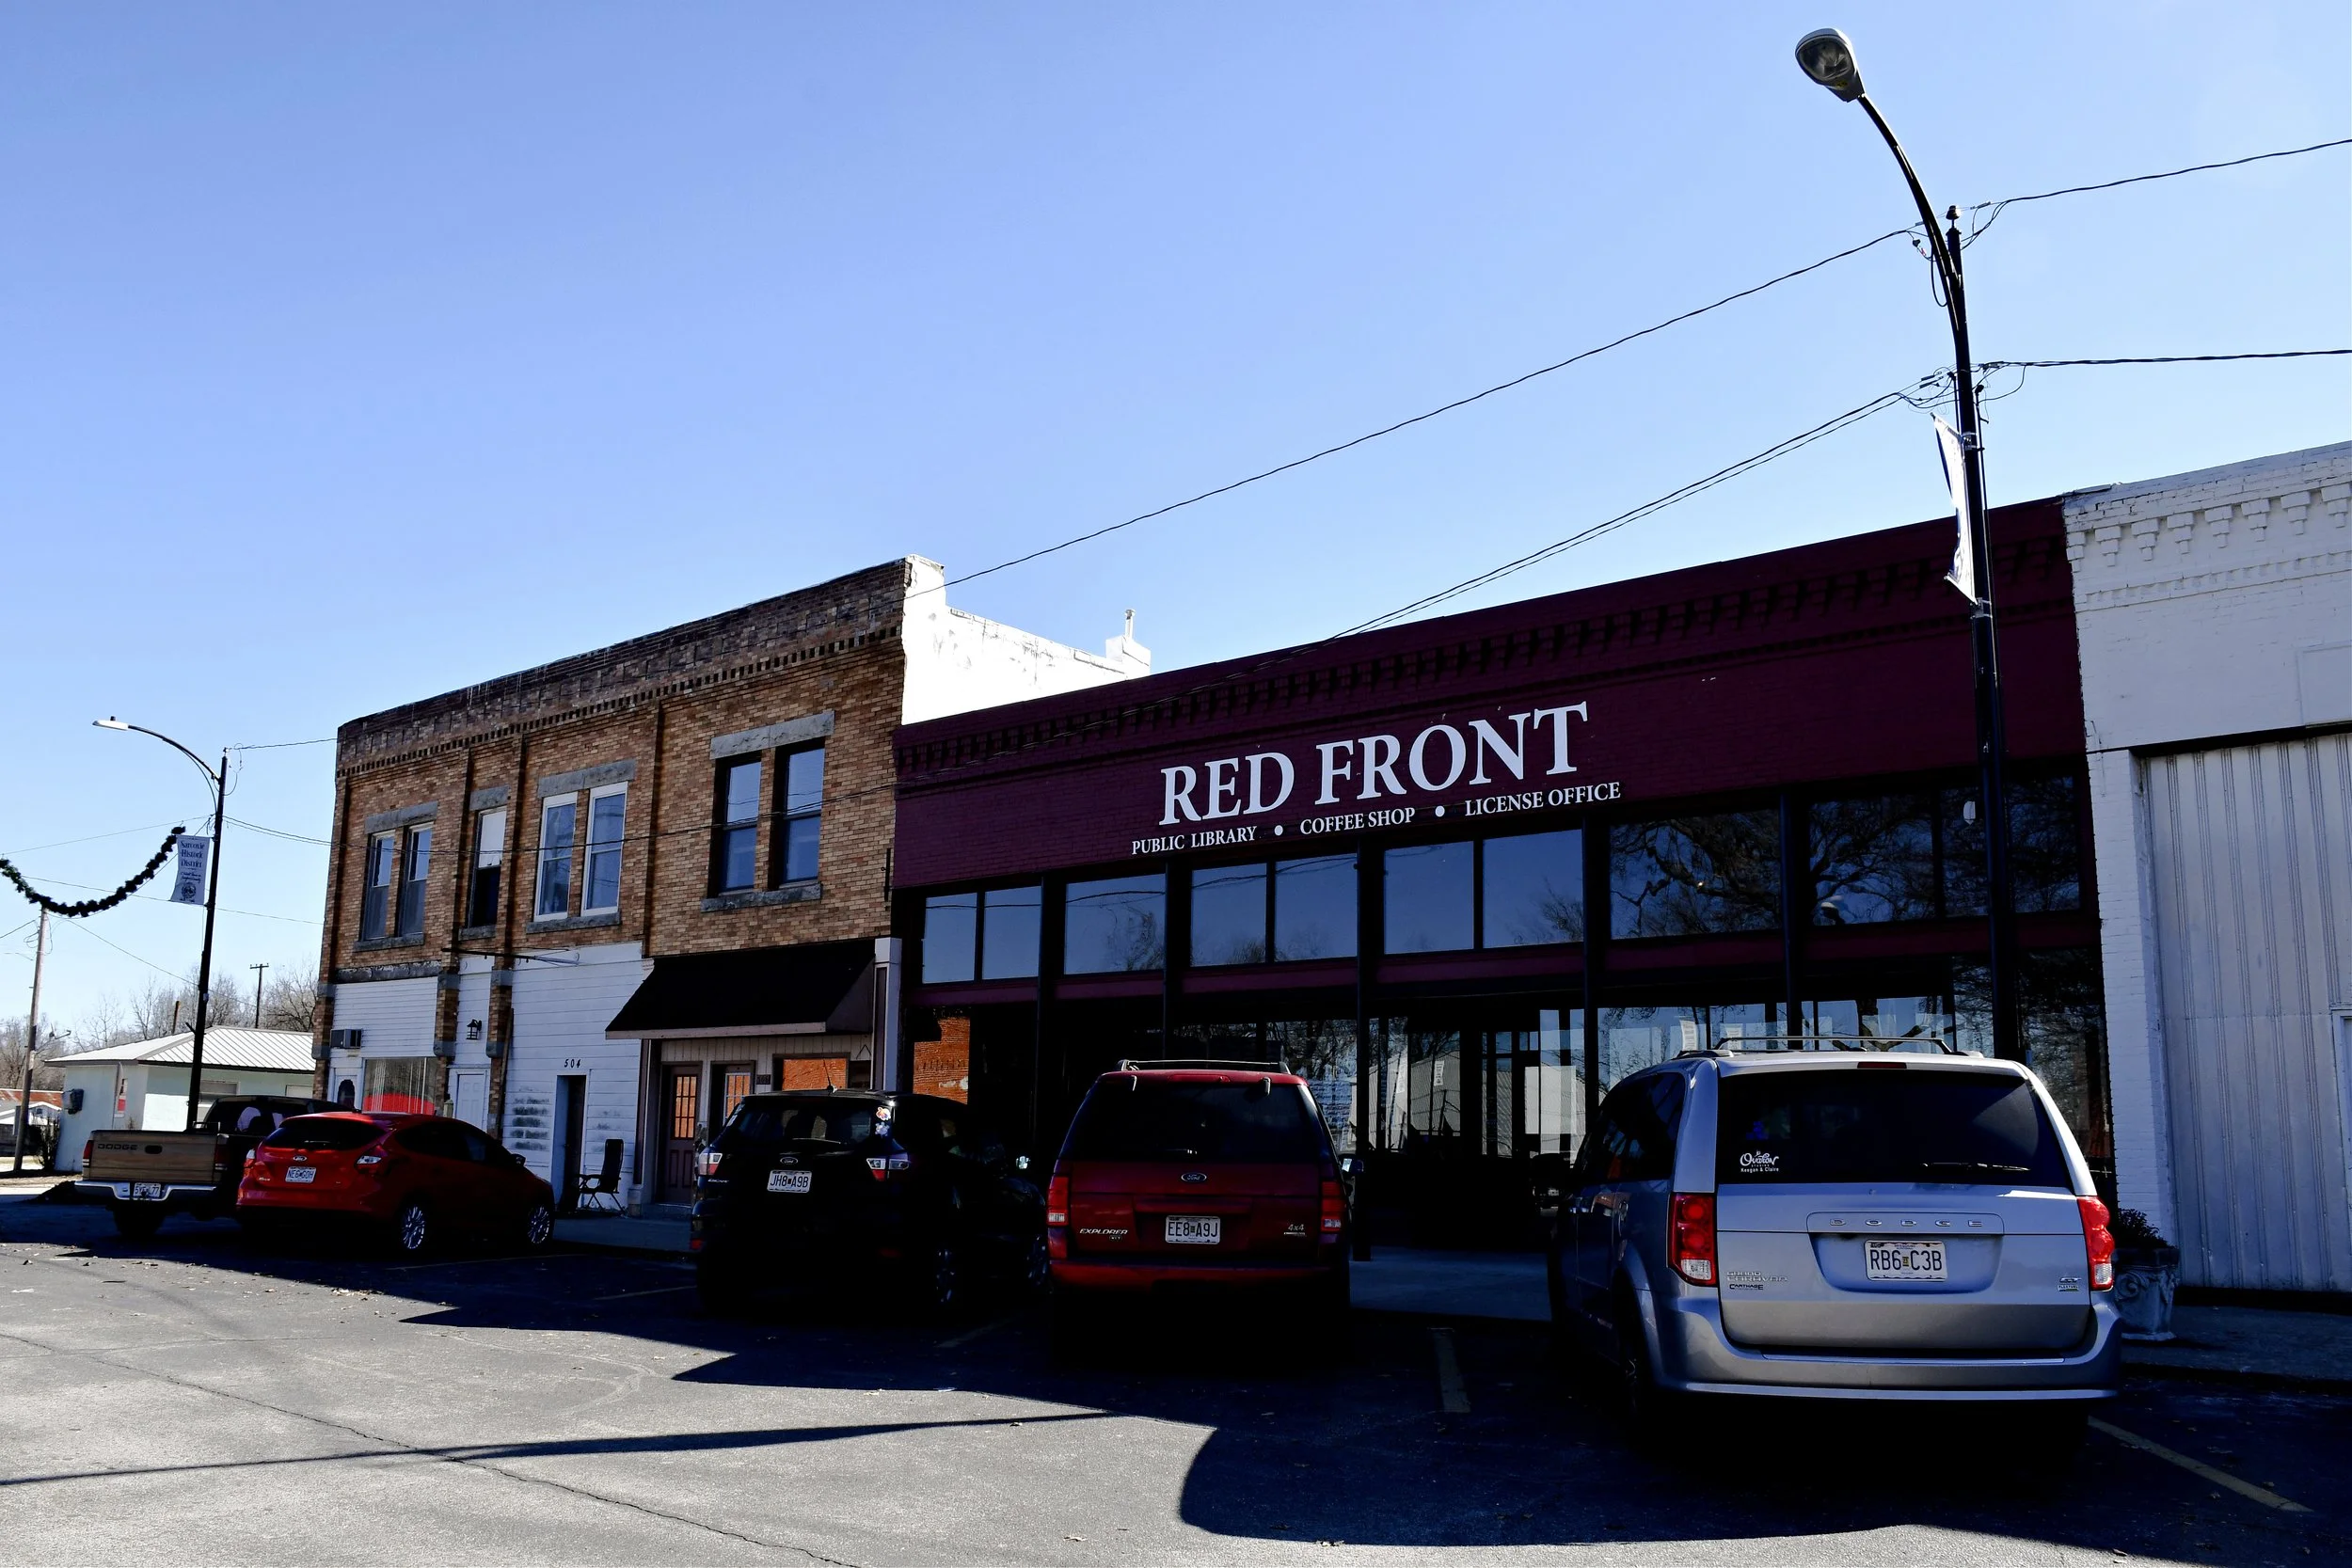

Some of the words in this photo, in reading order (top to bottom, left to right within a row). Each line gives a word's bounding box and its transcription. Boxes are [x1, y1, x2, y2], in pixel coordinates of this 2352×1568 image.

[1157, 752, 1295, 827] RED
[1314, 700, 1589, 806] FRONT
[1464, 791, 1544, 816] LICENSE
[1548, 782, 1621, 806] OFFICE
[1299, 813, 1365, 835] COFFEE
[1368, 807, 1416, 828] SHOP
[1131, 834, 1185, 855] PUBLIC
[1190, 825, 1258, 848] LIBRARY
[564, 1058, 581, 1069] 504
[1829, 1218, 1983, 1227] DODGE
